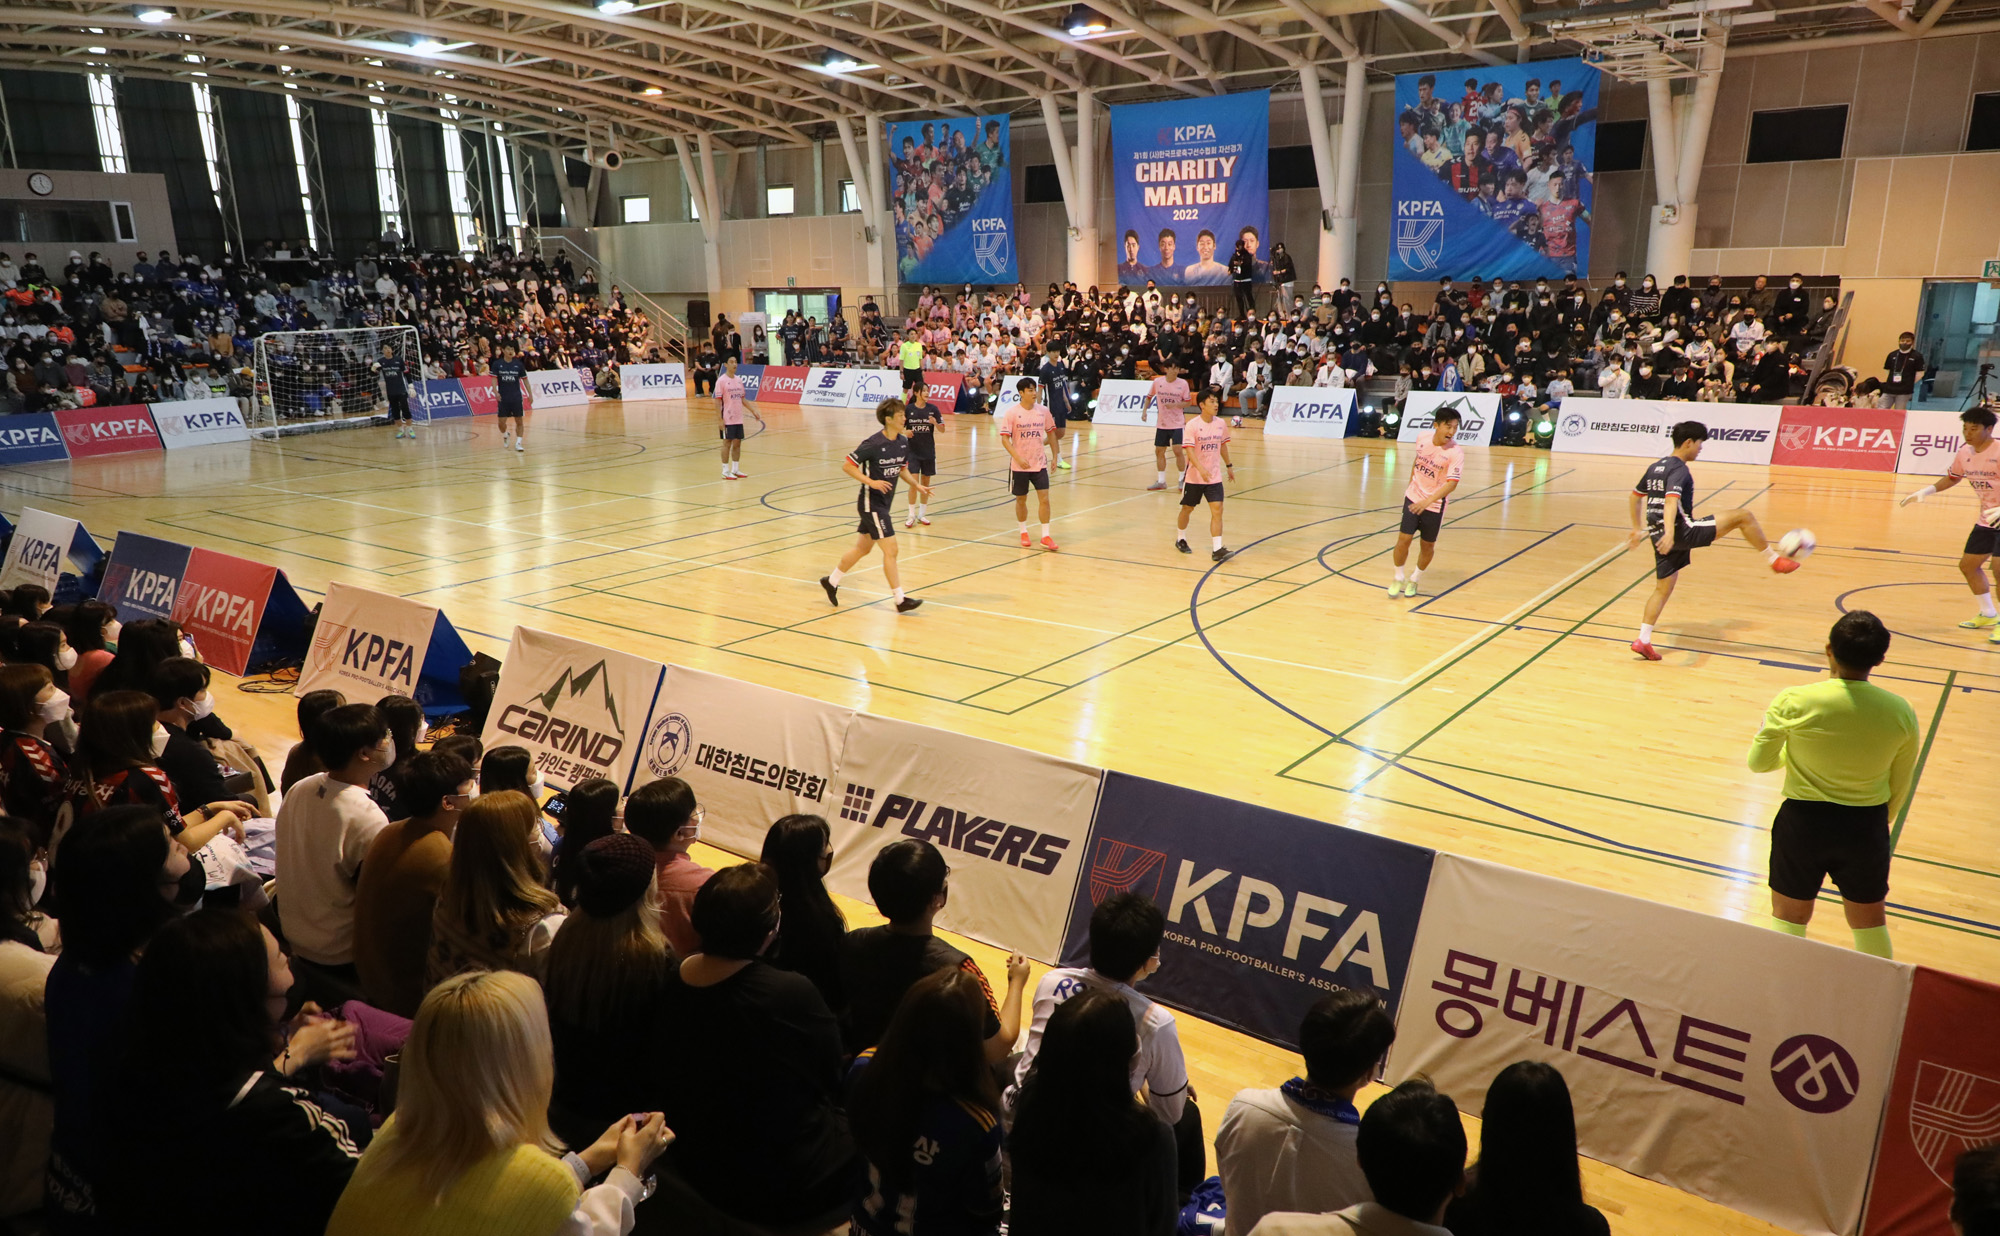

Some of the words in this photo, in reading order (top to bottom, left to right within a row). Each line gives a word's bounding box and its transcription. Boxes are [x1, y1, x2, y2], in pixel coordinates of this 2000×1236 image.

[1175, 124, 1216, 141] KPFA
[1136, 155, 1238, 182] CHARITY
[1144, 182, 1228, 207] MATCH
[1173, 208, 1199, 220] 2022
[1398, 200, 1444, 216] KPFA
[972, 217, 1007, 232] KPFA
[541, 380, 581, 395] KPFA
[642, 373, 683, 386] KPFA
[774, 377, 804, 391] KPFA
[419, 391, 464, 407] KPFA
[928, 384, 955, 399] PFA
[183, 411, 241, 429] KPFA
[1292, 403, 1343, 419] KPFA
[90, 419, 154, 438] KPFA
[1590, 421, 1660, 434] 대한침도의학회
[1707, 428, 1770, 442] AYERS
[1813, 426, 1896, 449] KPFA
[1415, 463, 1435, 478] KPFA
[1969, 480, 1993, 490] KPFA
[19, 537, 61, 575] KPFA
[125, 568, 177, 610] KPFA
[193, 586, 254, 636] KPFA
[342, 628, 414, 686] KPFA
[535, 751, 571, 777] 카인드
[695, 743, 828, 803] 대한침도의학회
[872, 793, 1070, 876] PLAYERS
[1166, 859, 1390, 990] KPFA
[1162, 929, 1197, 949] KOREA
[1200, 941, 1306, 983] PRO-FOOTBALLER'S
[1431, 949, 1752, 1106] 몽베스트
